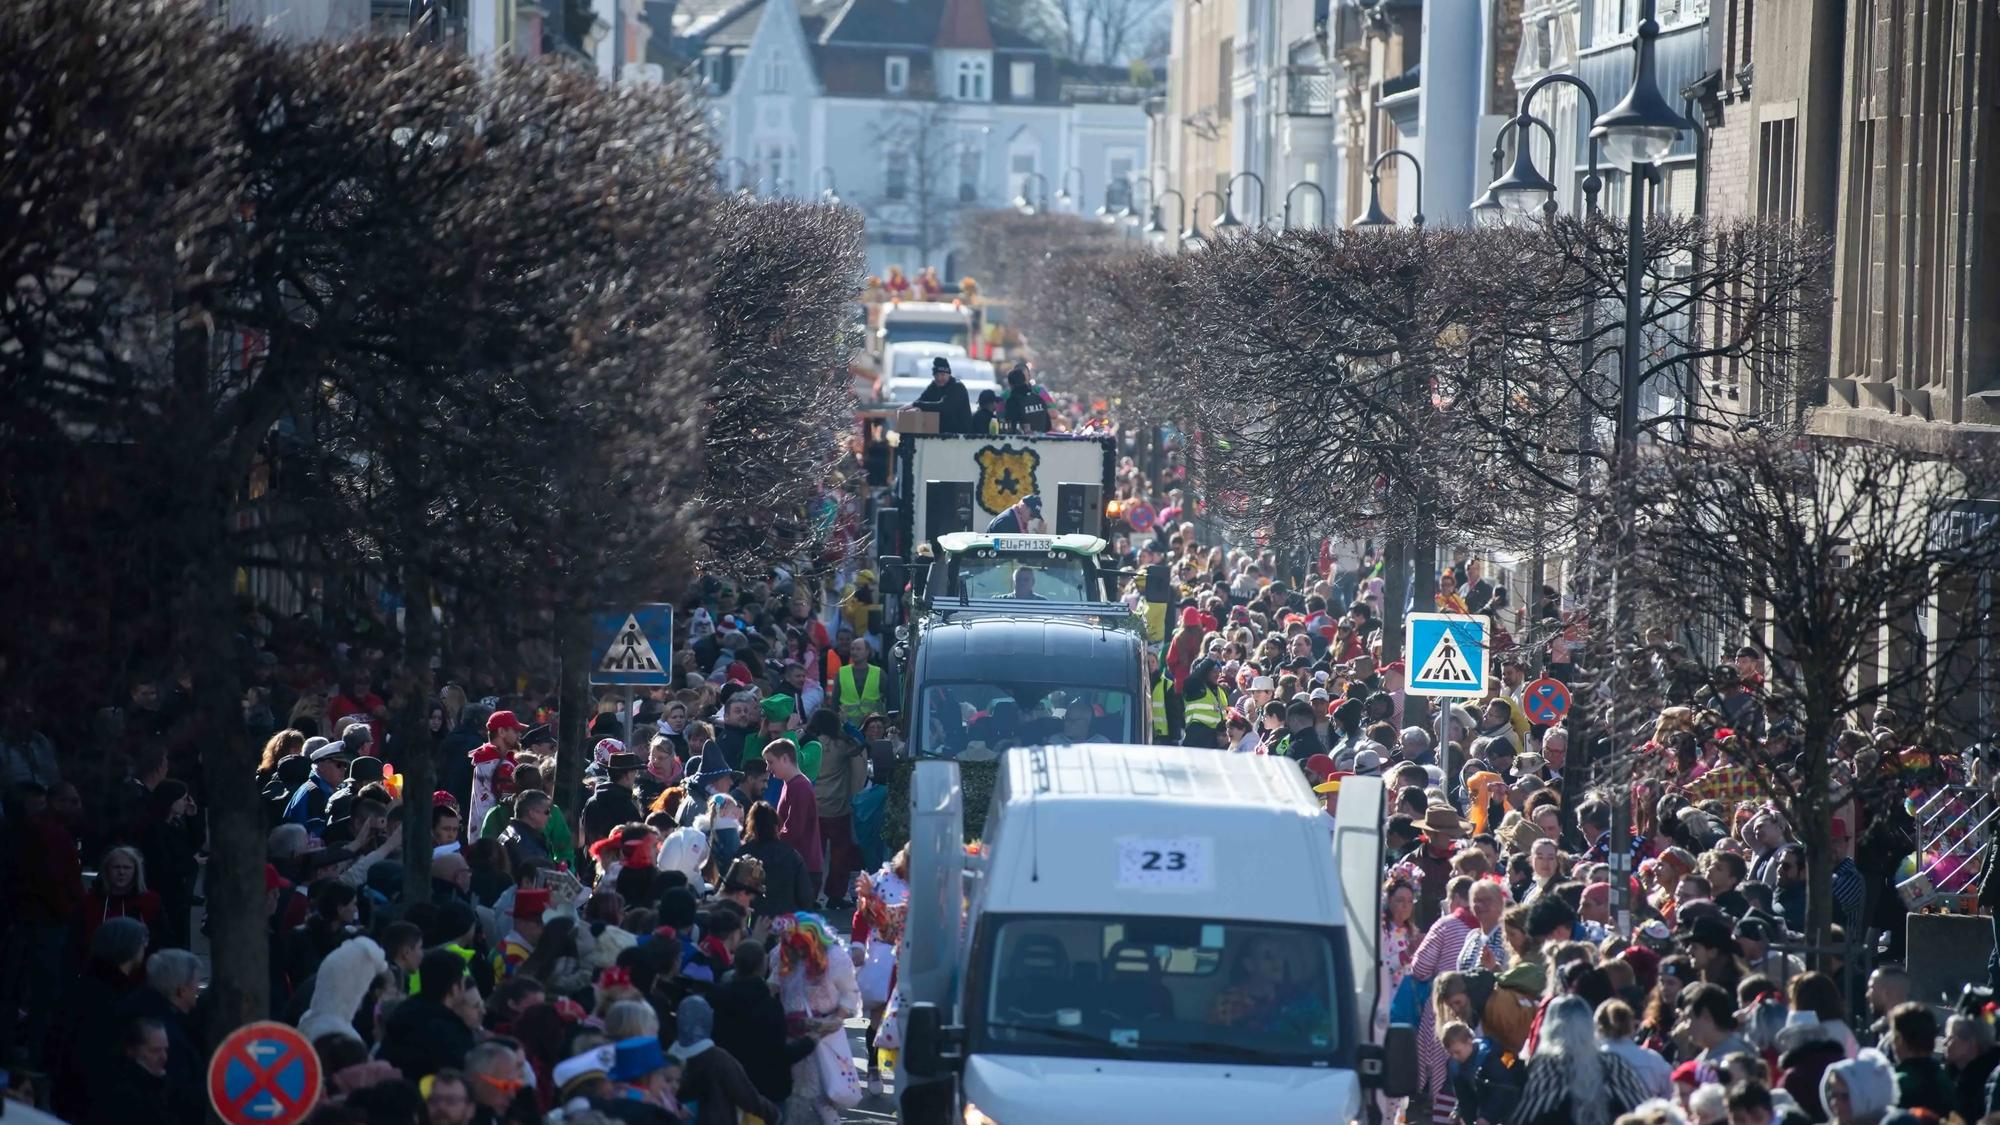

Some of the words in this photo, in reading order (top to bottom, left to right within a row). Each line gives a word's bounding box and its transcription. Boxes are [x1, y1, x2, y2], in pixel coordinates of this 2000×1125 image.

[1018, 539, 1031, 549] FH
[1033, 540, 1050, 550] 133
[1141, 850, 1187, 871] 23
